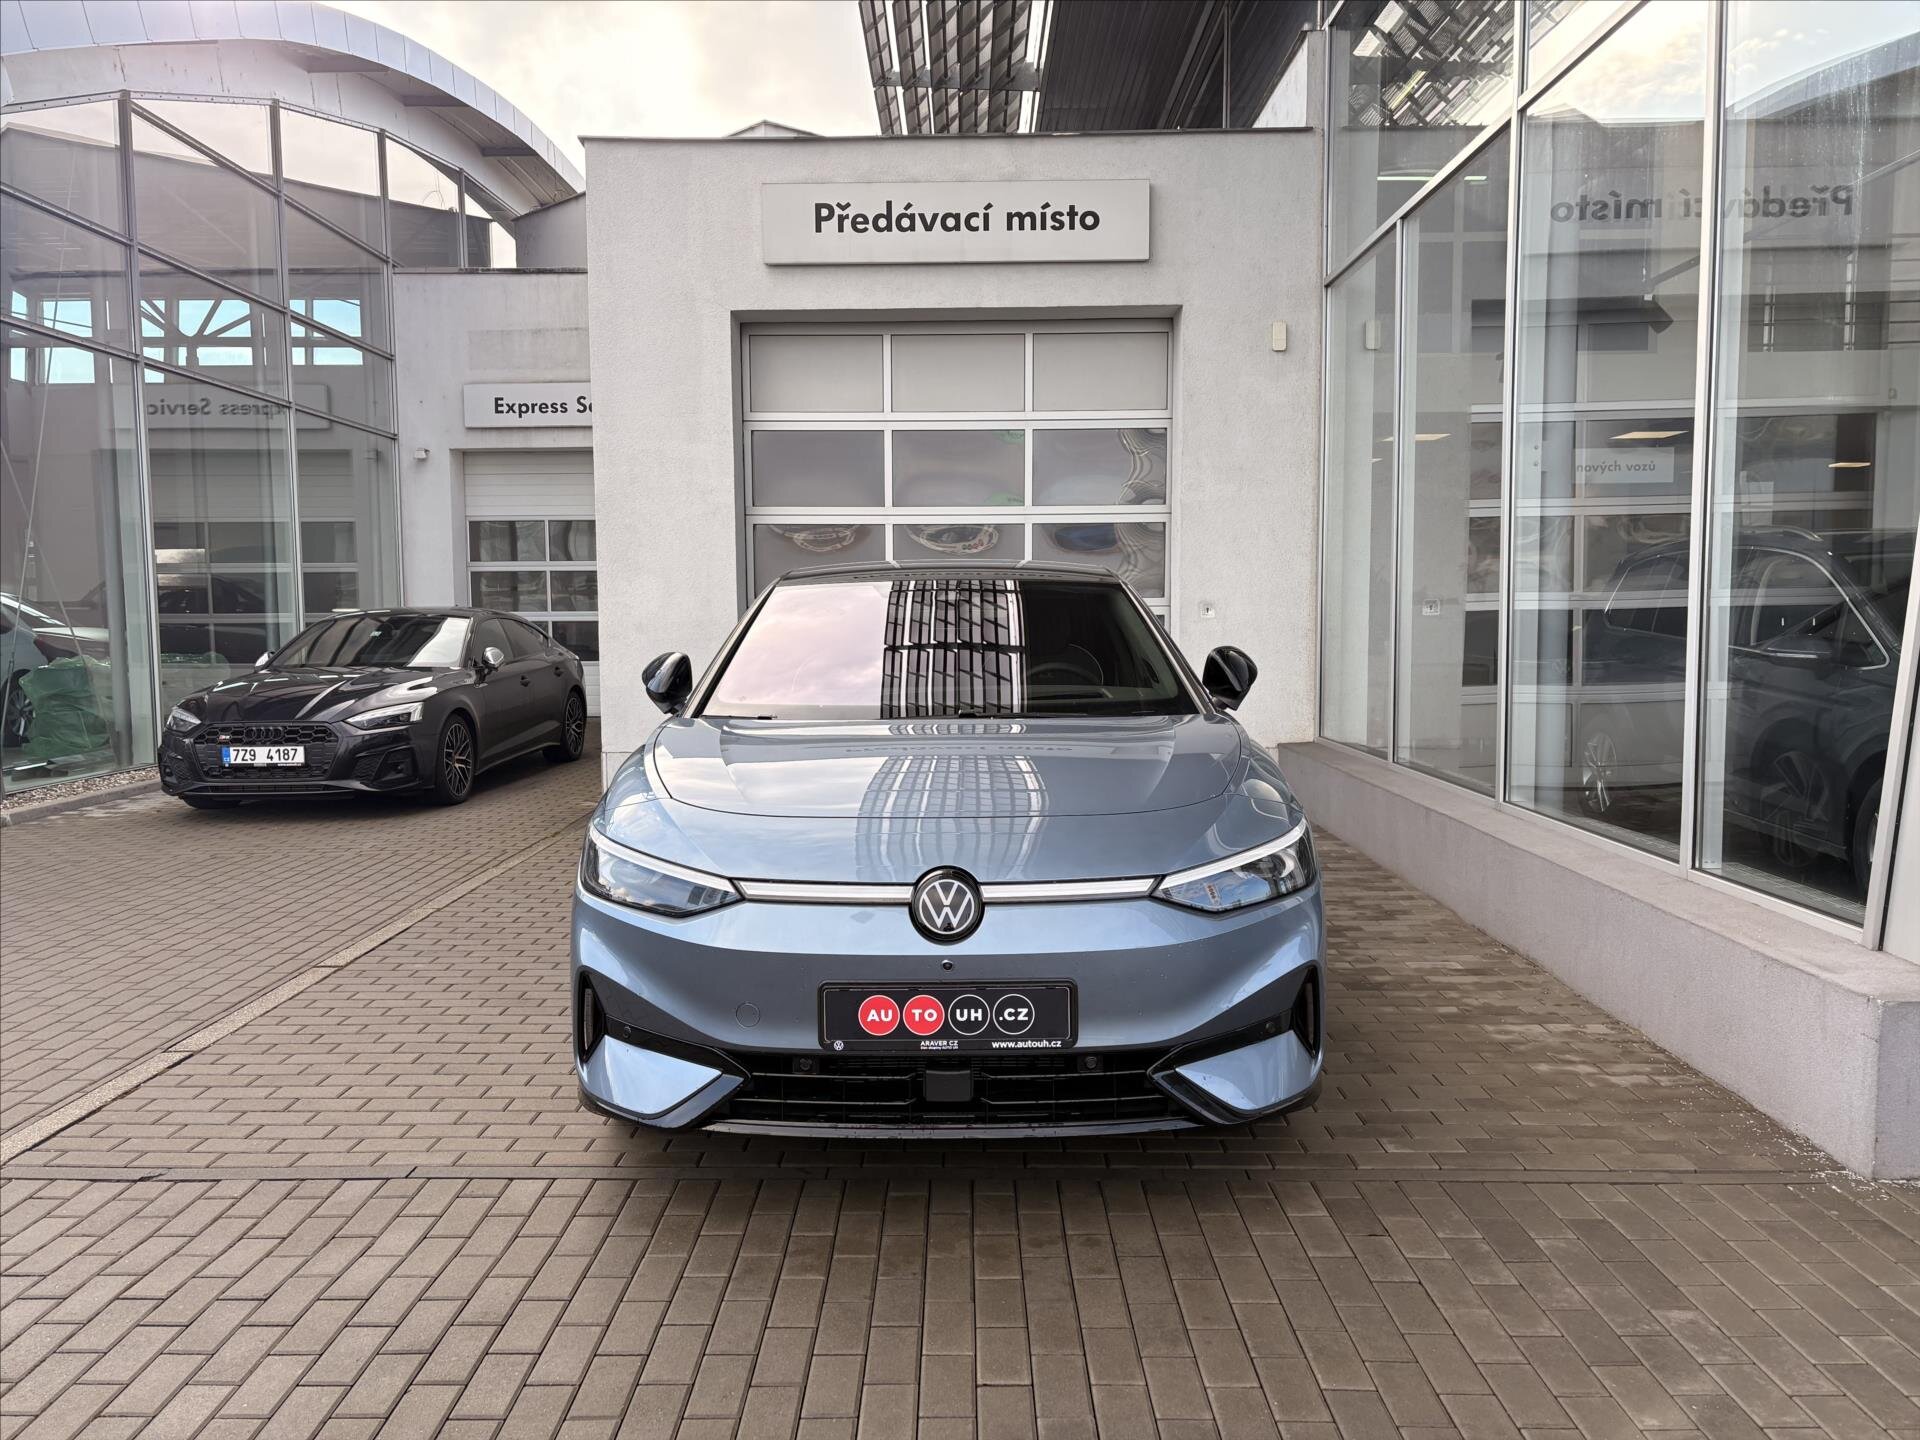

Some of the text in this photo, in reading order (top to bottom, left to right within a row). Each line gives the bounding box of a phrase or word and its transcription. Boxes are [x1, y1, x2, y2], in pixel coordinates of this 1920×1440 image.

[815, 200, 1100, 233] Předávací místo
[494, 397, 568, 418] Express
[1576, 460, 1656, 474] nových vozů
[233, 748, 298, 761] 7Z9 4187
[866, 1007, 1029, 1022] AU TO UH .CZ
[991, 1040, 1062, 1049] www.autouh.cz
